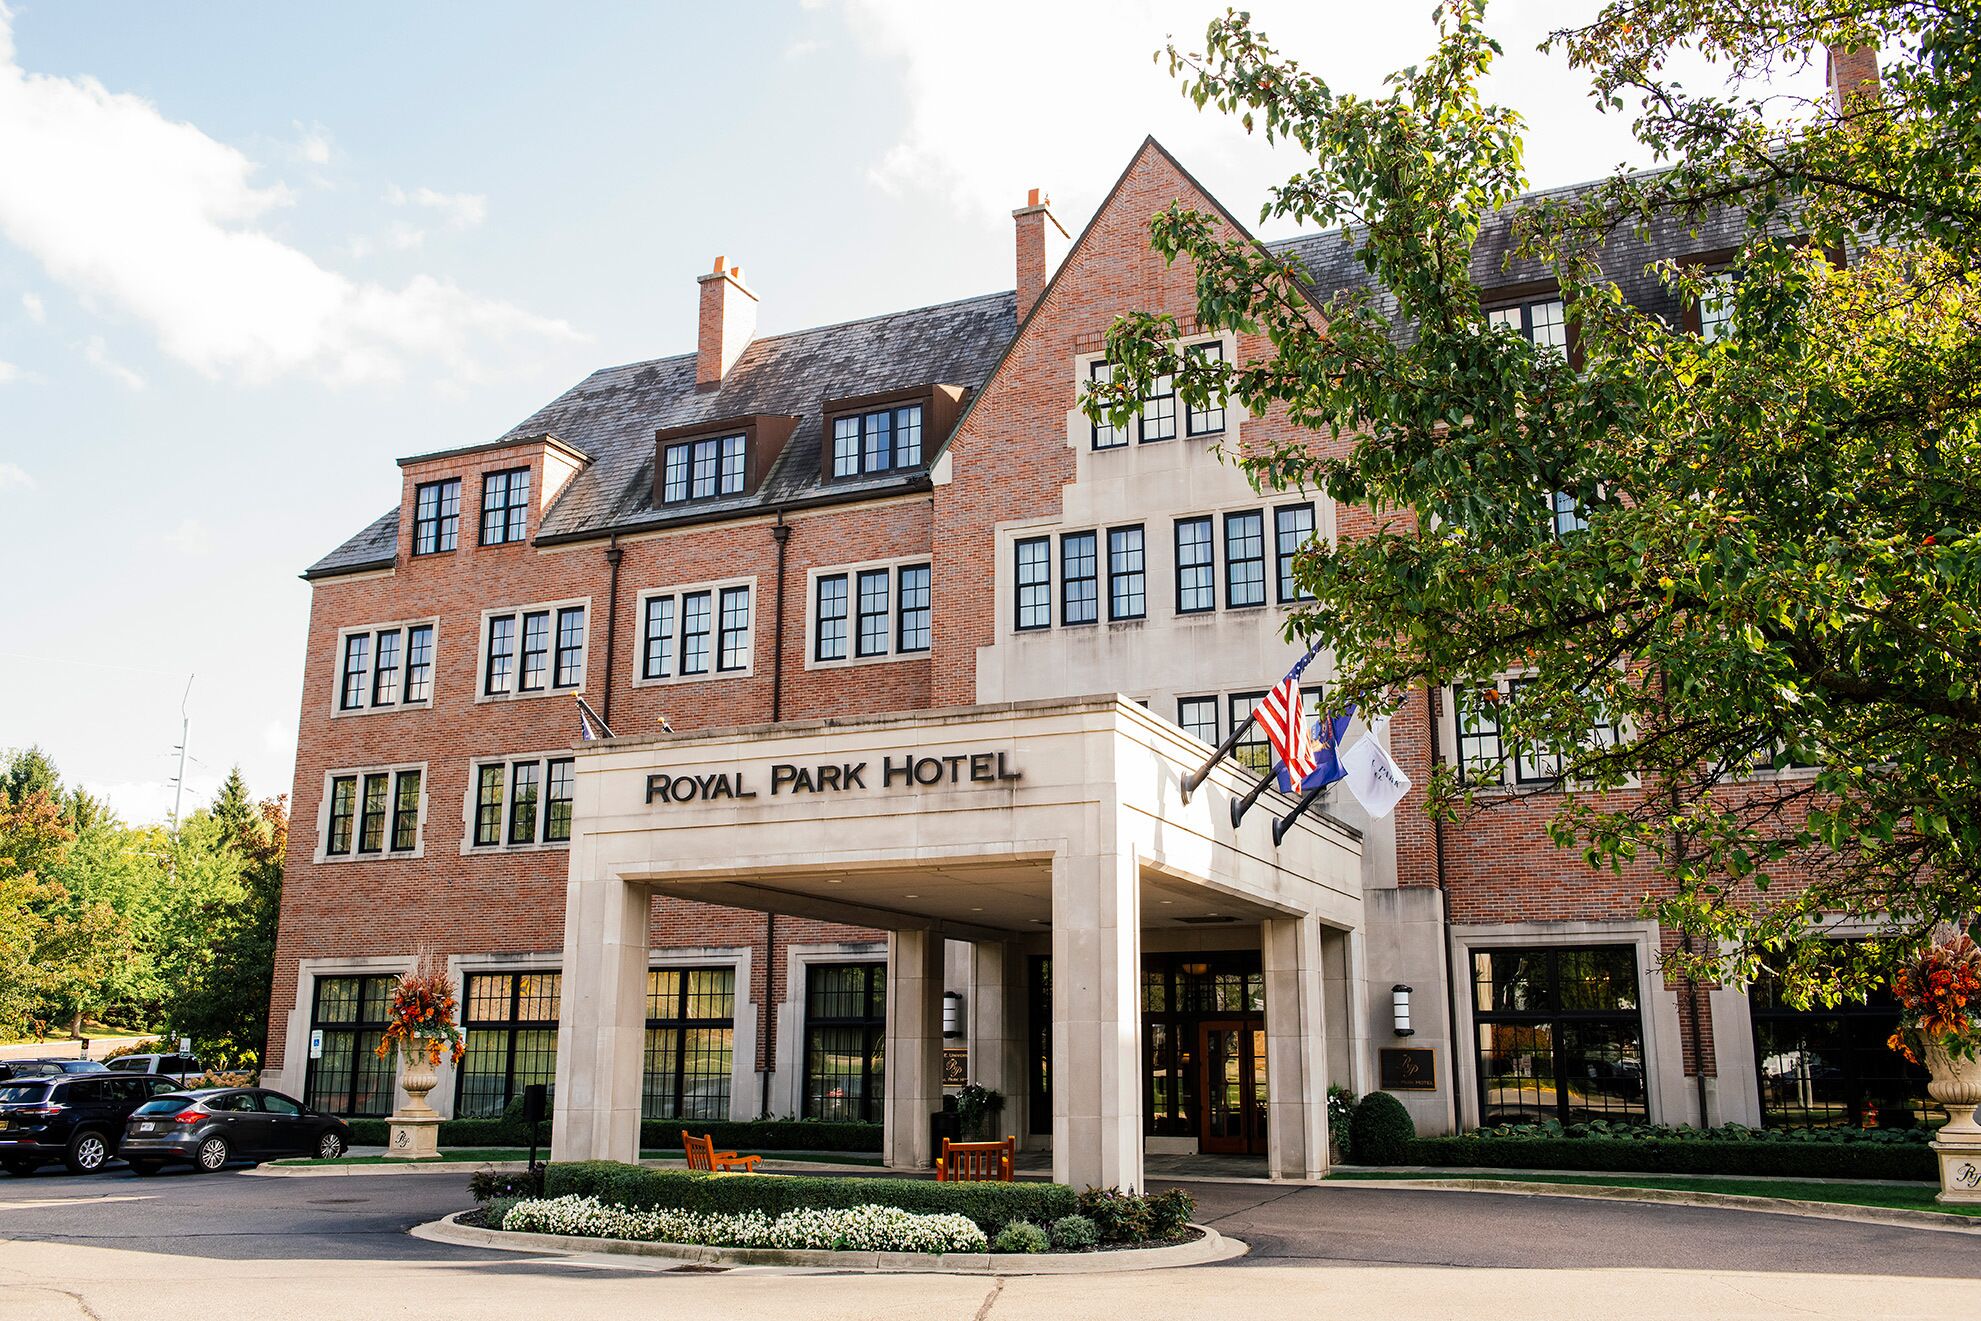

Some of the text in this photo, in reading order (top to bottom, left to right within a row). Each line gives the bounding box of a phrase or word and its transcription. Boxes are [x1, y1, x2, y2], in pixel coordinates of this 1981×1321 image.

[645, 752, 1021, 804] ROYAL PARK HOTEL
